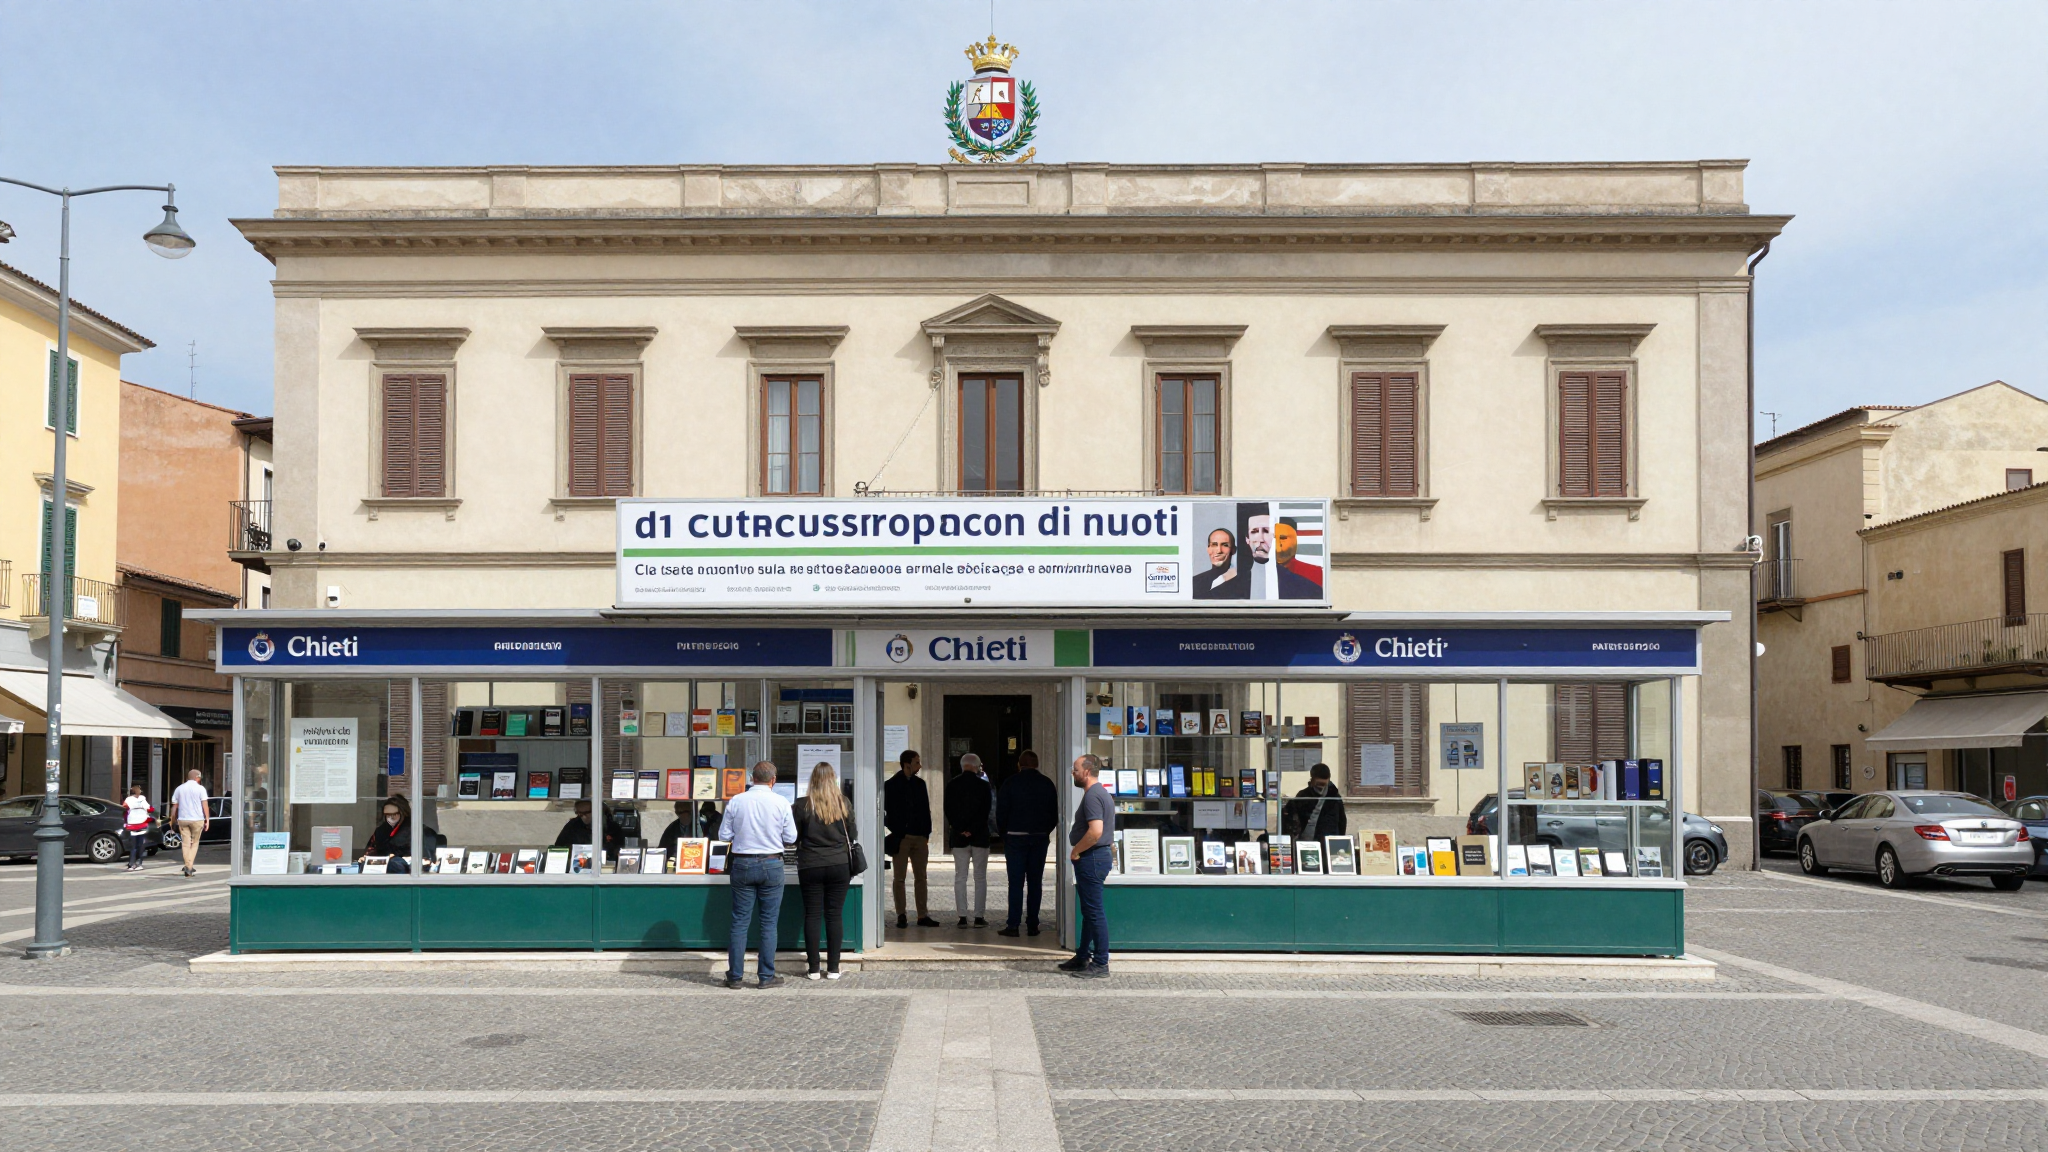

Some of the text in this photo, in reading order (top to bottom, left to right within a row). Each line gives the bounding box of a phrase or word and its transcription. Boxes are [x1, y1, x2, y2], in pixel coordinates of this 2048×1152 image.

[1038, 505, 1070, 536] di
[1084, 505, 1178, 537] nuoti
[287, 635, 359, 657] Chieti
[928, 635, 1028, 662] Chieti
